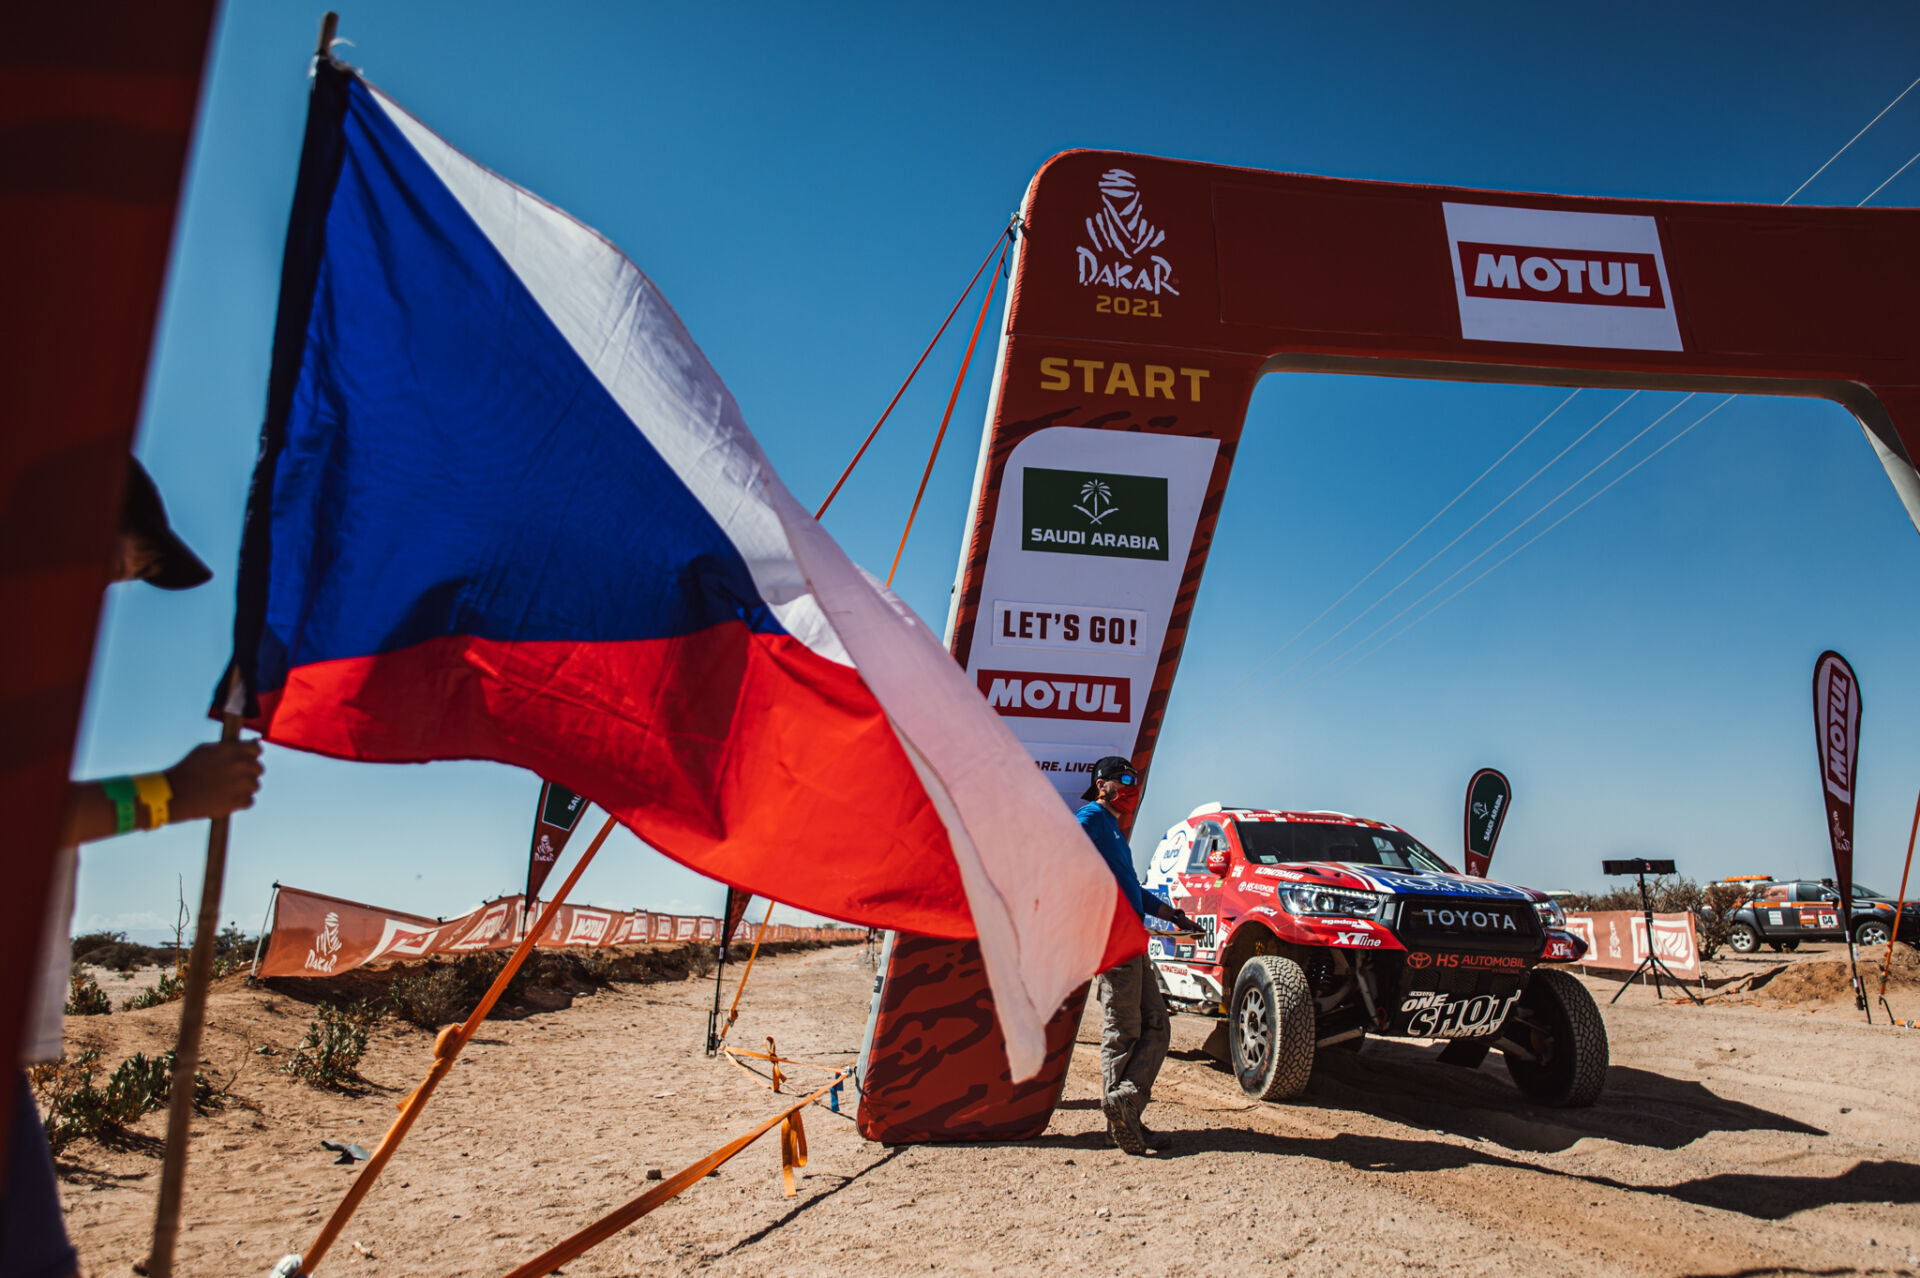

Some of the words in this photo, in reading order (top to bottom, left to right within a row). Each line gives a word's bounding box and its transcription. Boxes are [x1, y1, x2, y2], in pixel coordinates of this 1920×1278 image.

[1076, 246, 1179, 296] DAKAR
[1474, 253, 1650, 297] MOTUL
[1096, 295, 1162, 317] 2021
[1040, 357, 1210, 402] START
[1031, 527, 1086, 546] SAUDI
[1091, 533, 1160, 550] ARABIA
[1002, 610, 1080, 642] LET'S
[1089, 615, 1137, 646] GO!
[988, 678, 1122, 714] MOTUL
[1830, 674, 1848, 785] MOTUL
[1422, 908, 1516, 931] TOYOTA
[1332, 931, 1381, 947] XTline
[1437, 954, 1459, 968] HS
[1461, 956, 1526, 968] AUTOMOBIL
[1401, 993, 1450, 1012] ONE
